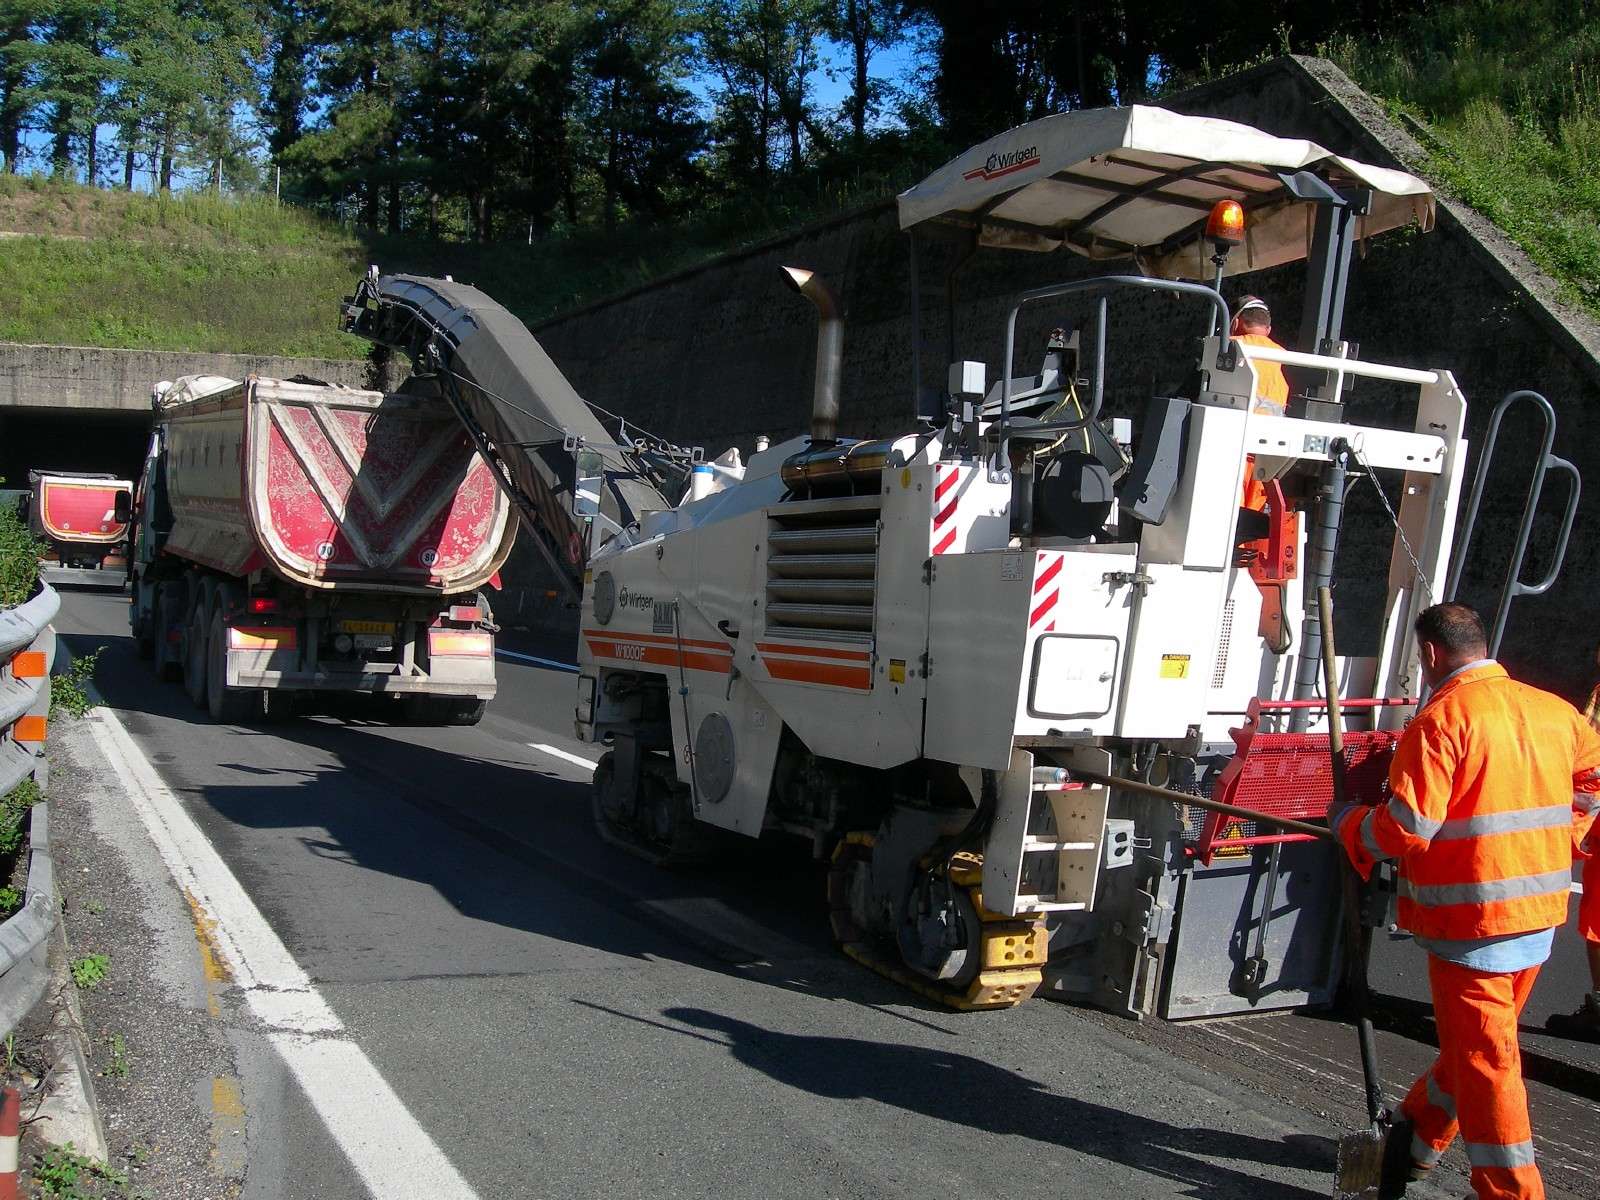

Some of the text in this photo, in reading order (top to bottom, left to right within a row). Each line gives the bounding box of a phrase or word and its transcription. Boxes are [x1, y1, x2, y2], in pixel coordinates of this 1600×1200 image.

[998, 146, 1037, 168] Wirtgen
[424, 552, 435, 562] 80
[629, 592, 654, 611] Wirtgen
[615, 643, 646, 661] W1000F
